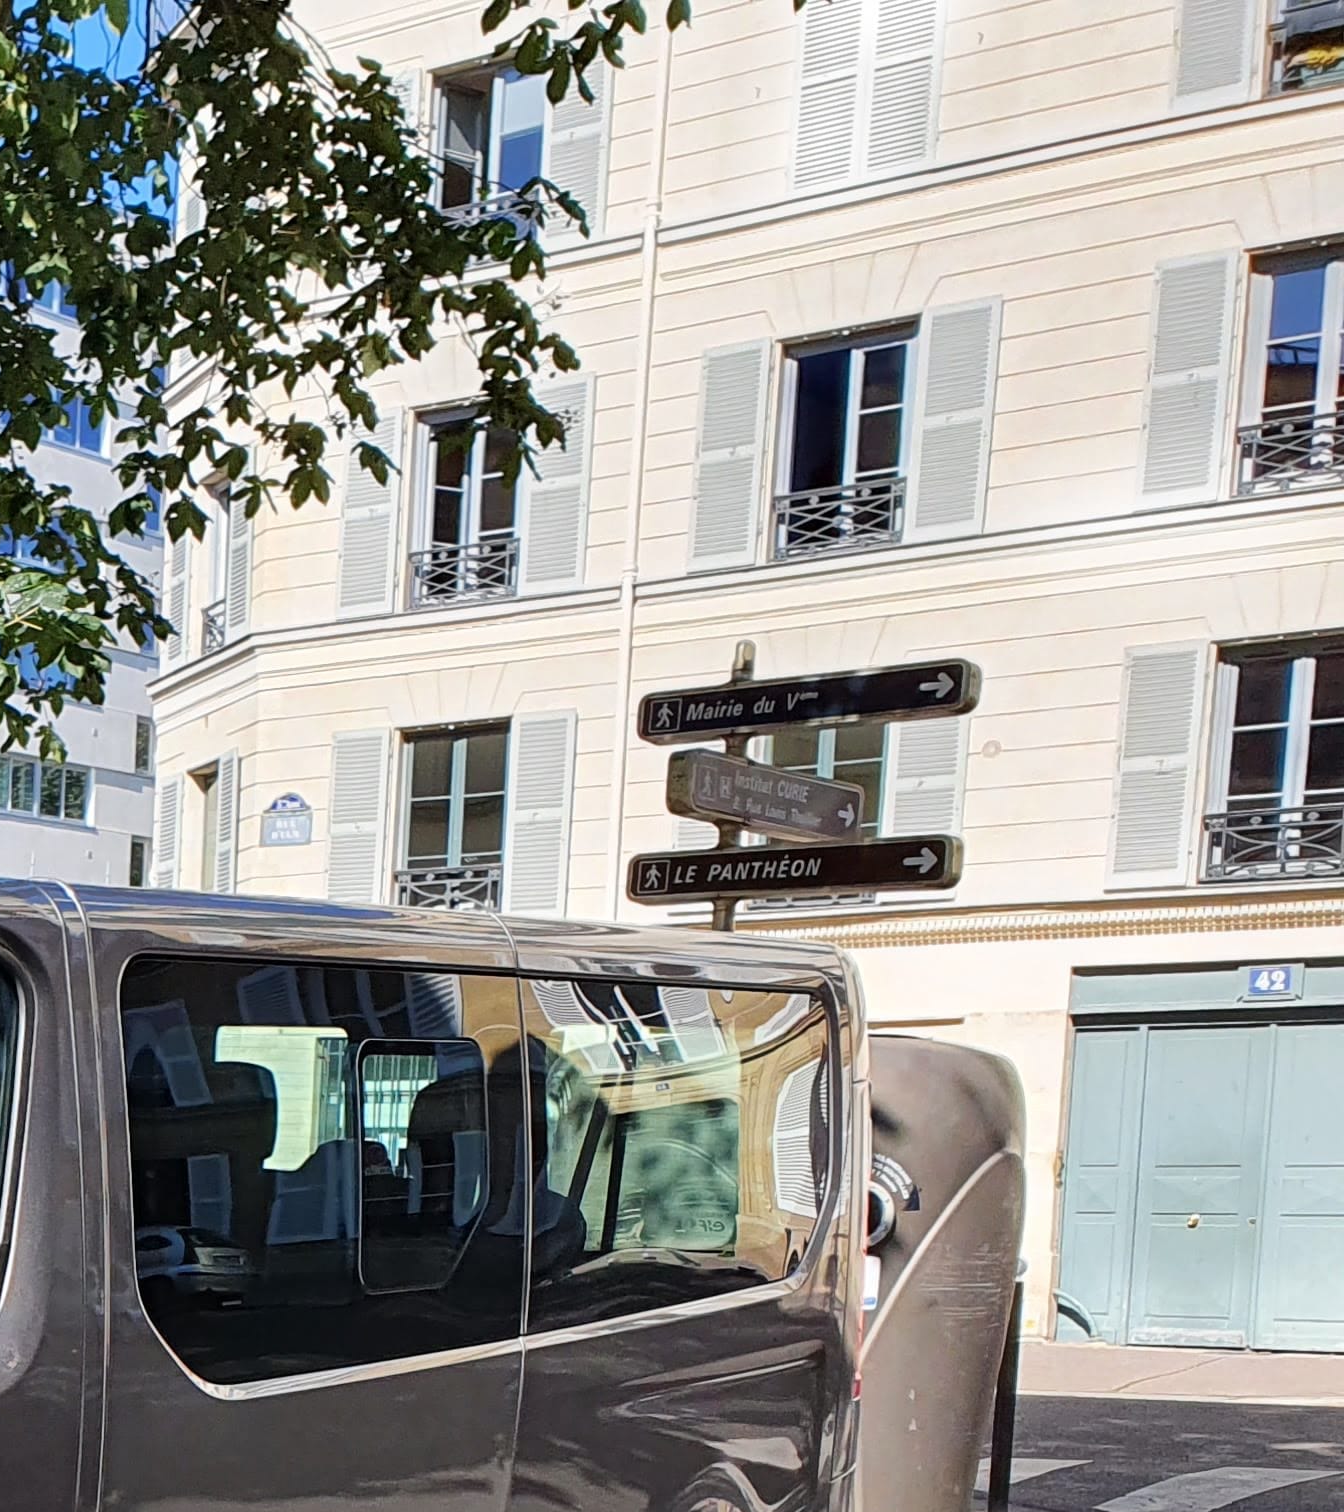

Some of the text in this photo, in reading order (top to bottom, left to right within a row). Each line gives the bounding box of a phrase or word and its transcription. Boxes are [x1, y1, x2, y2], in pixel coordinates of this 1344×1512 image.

[686, 699, 743, 721] Mairie
[753, 696, 776, 715] du
[777, 780, 810, 803] CURIE
[673, 854, 822, 884] LE PANTHÉON
[1254, 970, 1286, 991] 42
